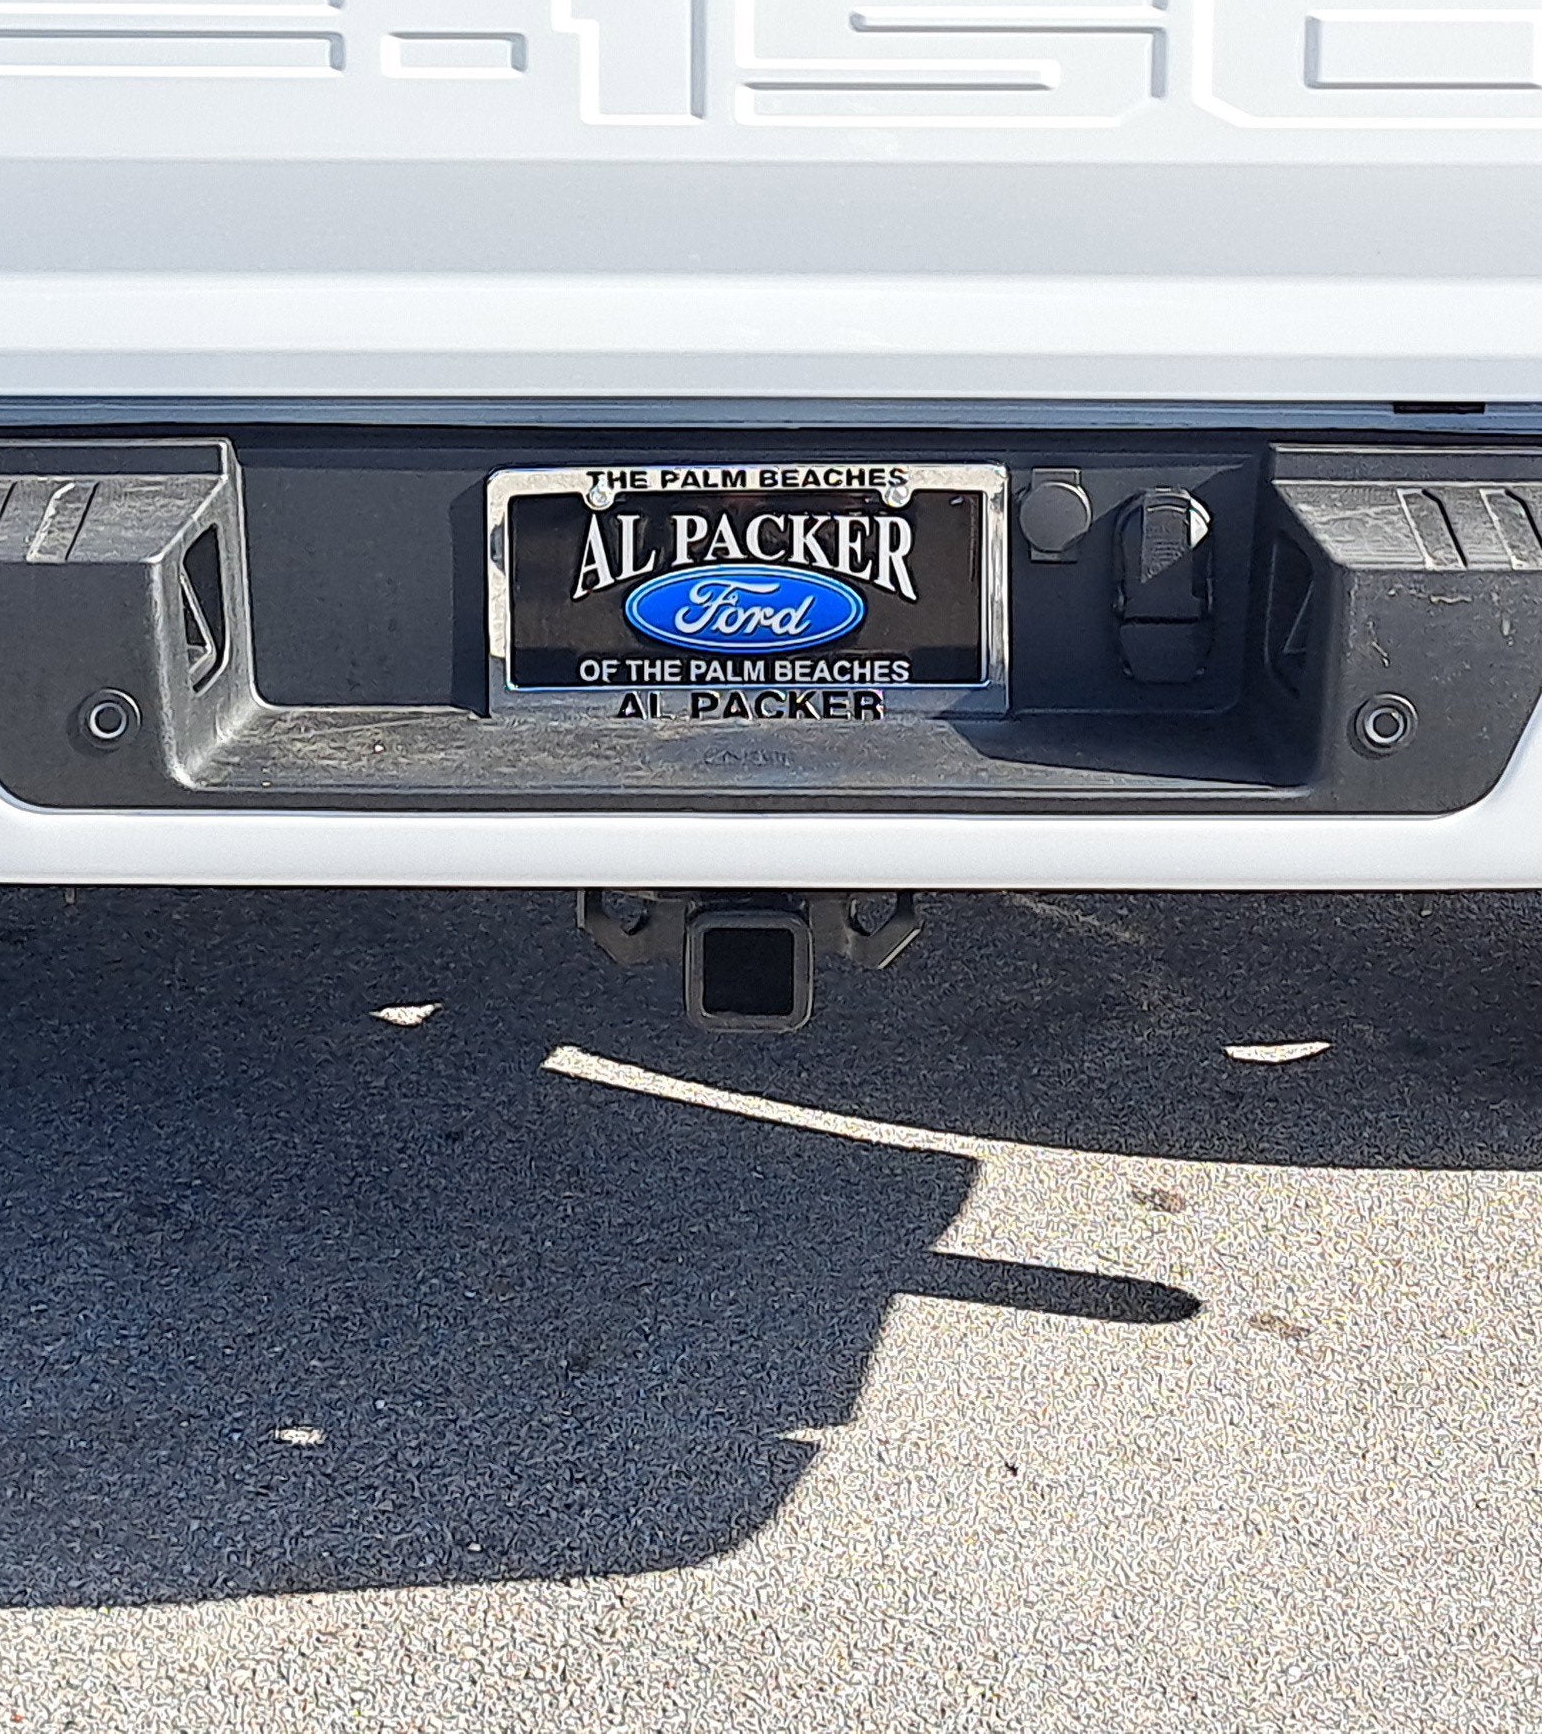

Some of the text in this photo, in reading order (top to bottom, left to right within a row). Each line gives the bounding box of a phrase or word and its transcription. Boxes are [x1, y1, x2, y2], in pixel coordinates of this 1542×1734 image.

[586, 468, 909, 489] THE PALM BEACHES
[572, 513, 918, 601] AL PACKER
[675, 579, 816, 635] Ford
[579, 659, 910, 683] OF THE PALM BEACHES
[617, 689, 885, 720] AL PACKER
